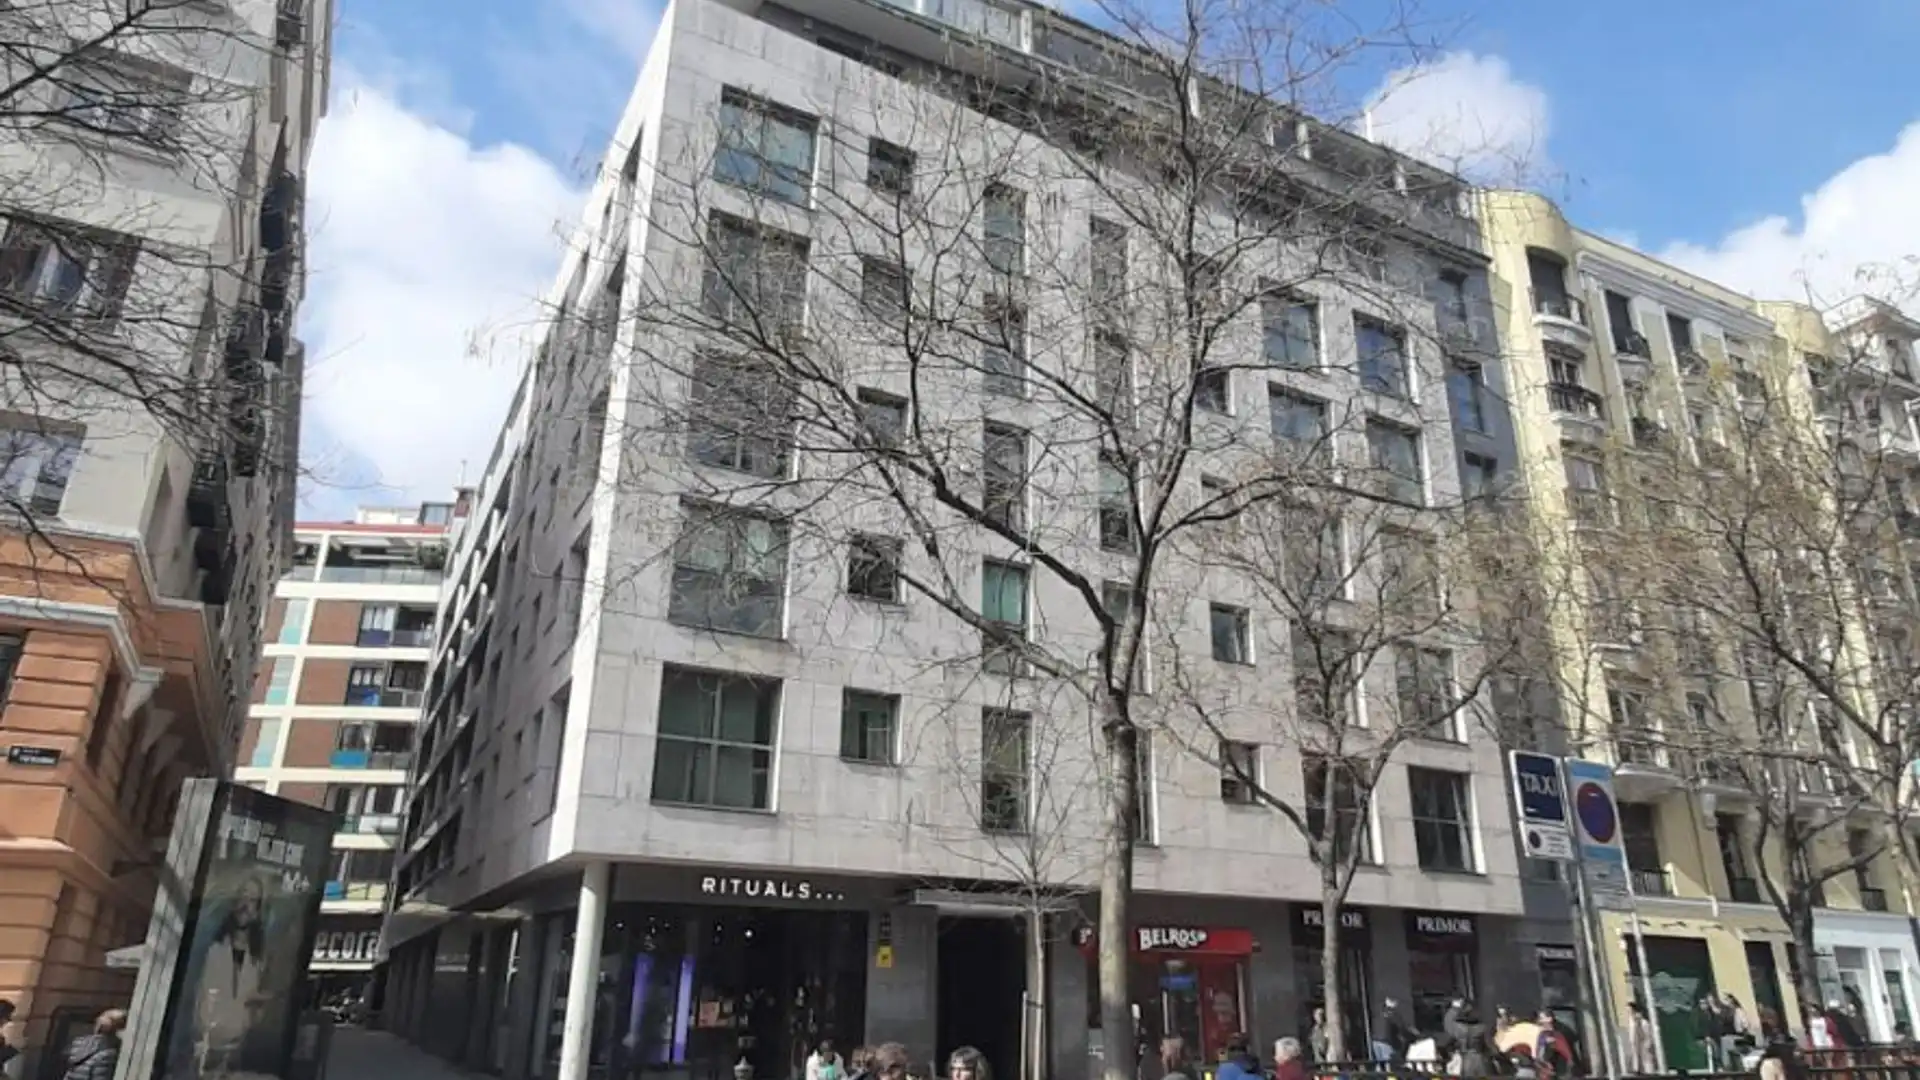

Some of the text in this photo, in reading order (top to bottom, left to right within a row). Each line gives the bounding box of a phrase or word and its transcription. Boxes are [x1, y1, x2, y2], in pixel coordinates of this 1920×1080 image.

[1520, 772, 1559, 797] TAXI
[701, 876, 845, 900] RITUALS...
[1302, 909, 1363, 928] PROR
[1417, 916, 1473, 933] PRIMOR
